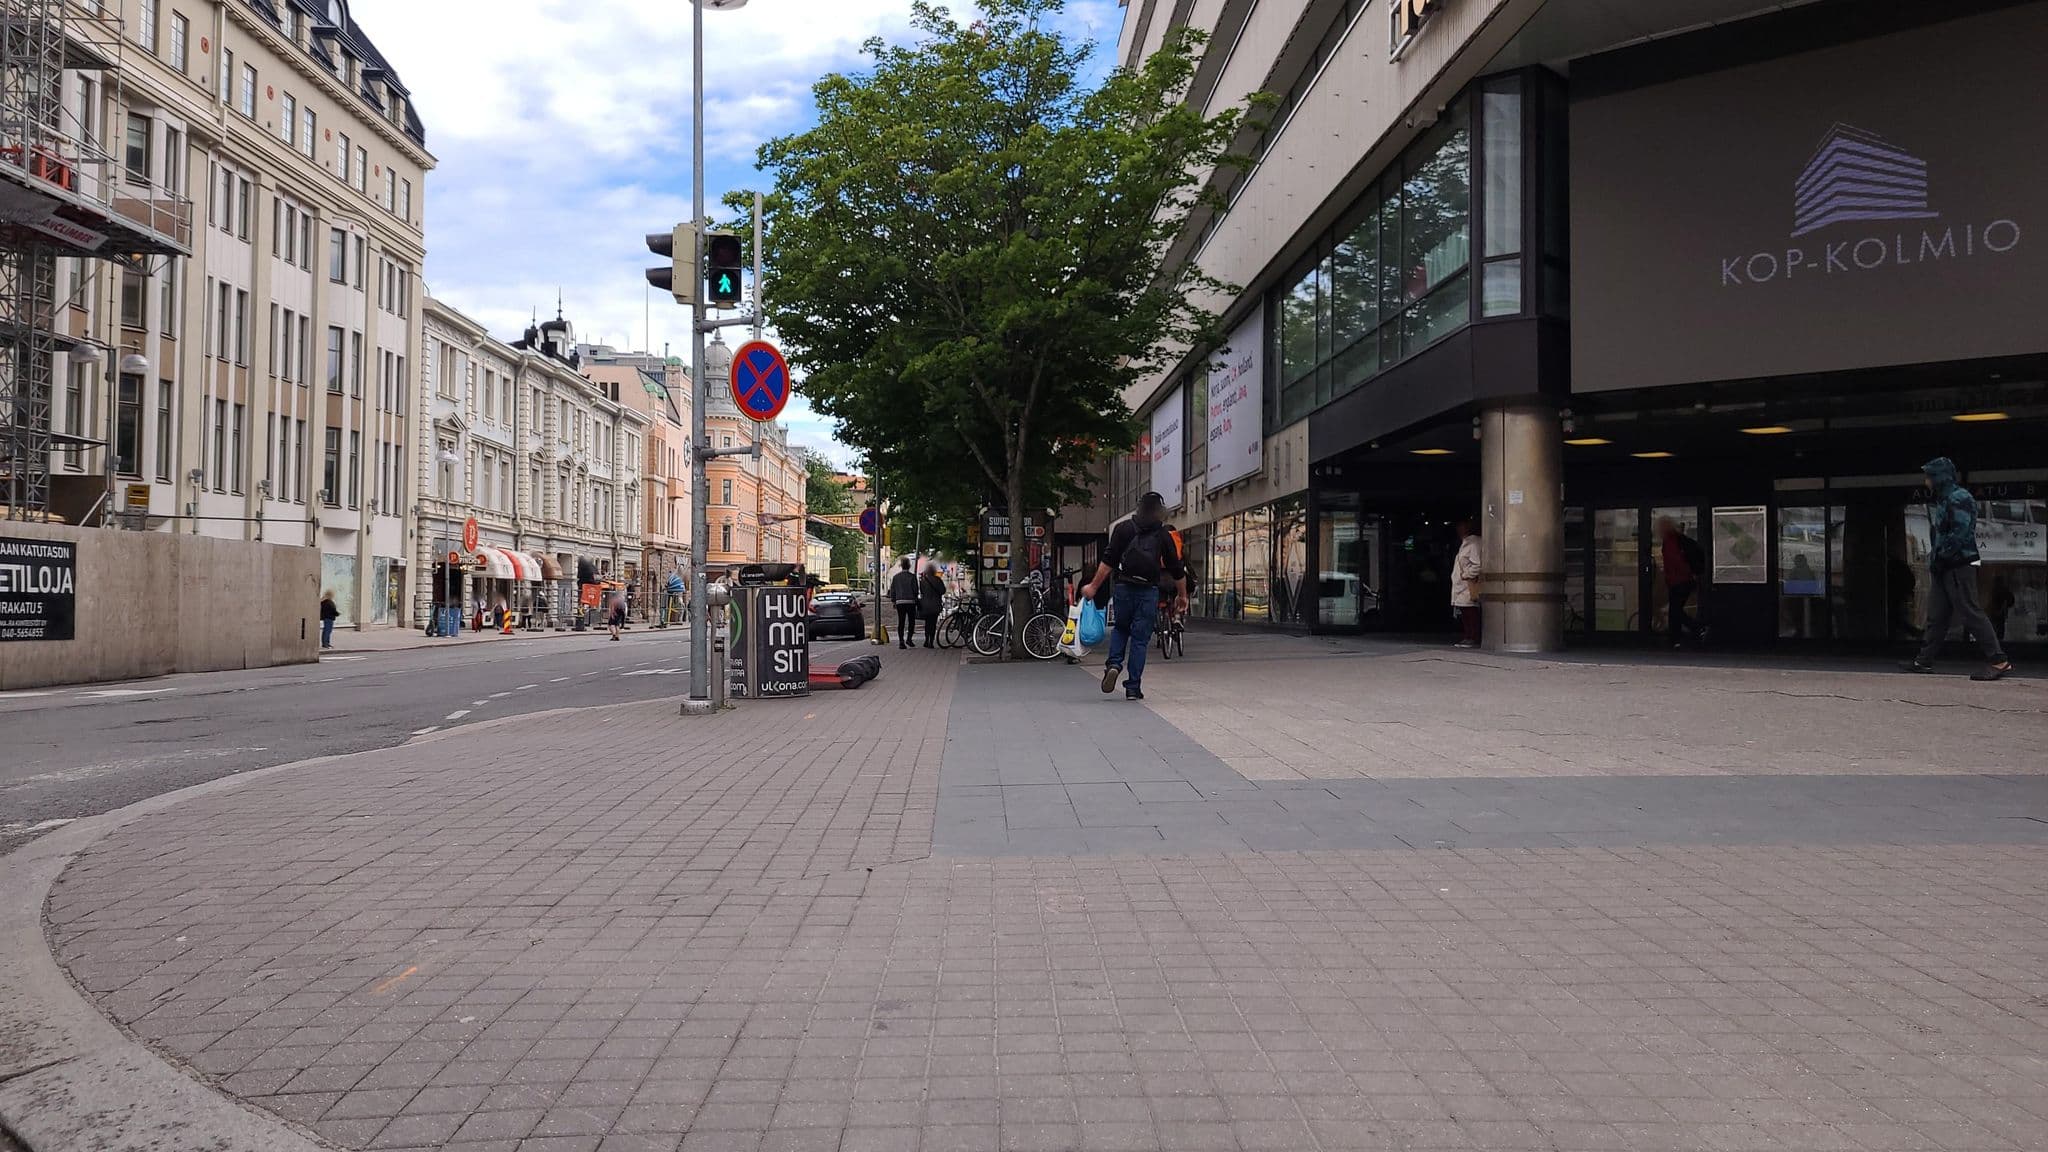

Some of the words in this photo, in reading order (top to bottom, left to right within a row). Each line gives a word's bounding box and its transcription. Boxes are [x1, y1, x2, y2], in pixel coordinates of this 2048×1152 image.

[1722, 219, 2021, 286] KOP-KOLMIO
[21, 544, 70, 558] KATUTASON
[38, 602, 43, 614] 5
[765, 594, 805, 619] HUO
[769, 622, 805, 646] MA
[774, 649, 804, 673] SIT
